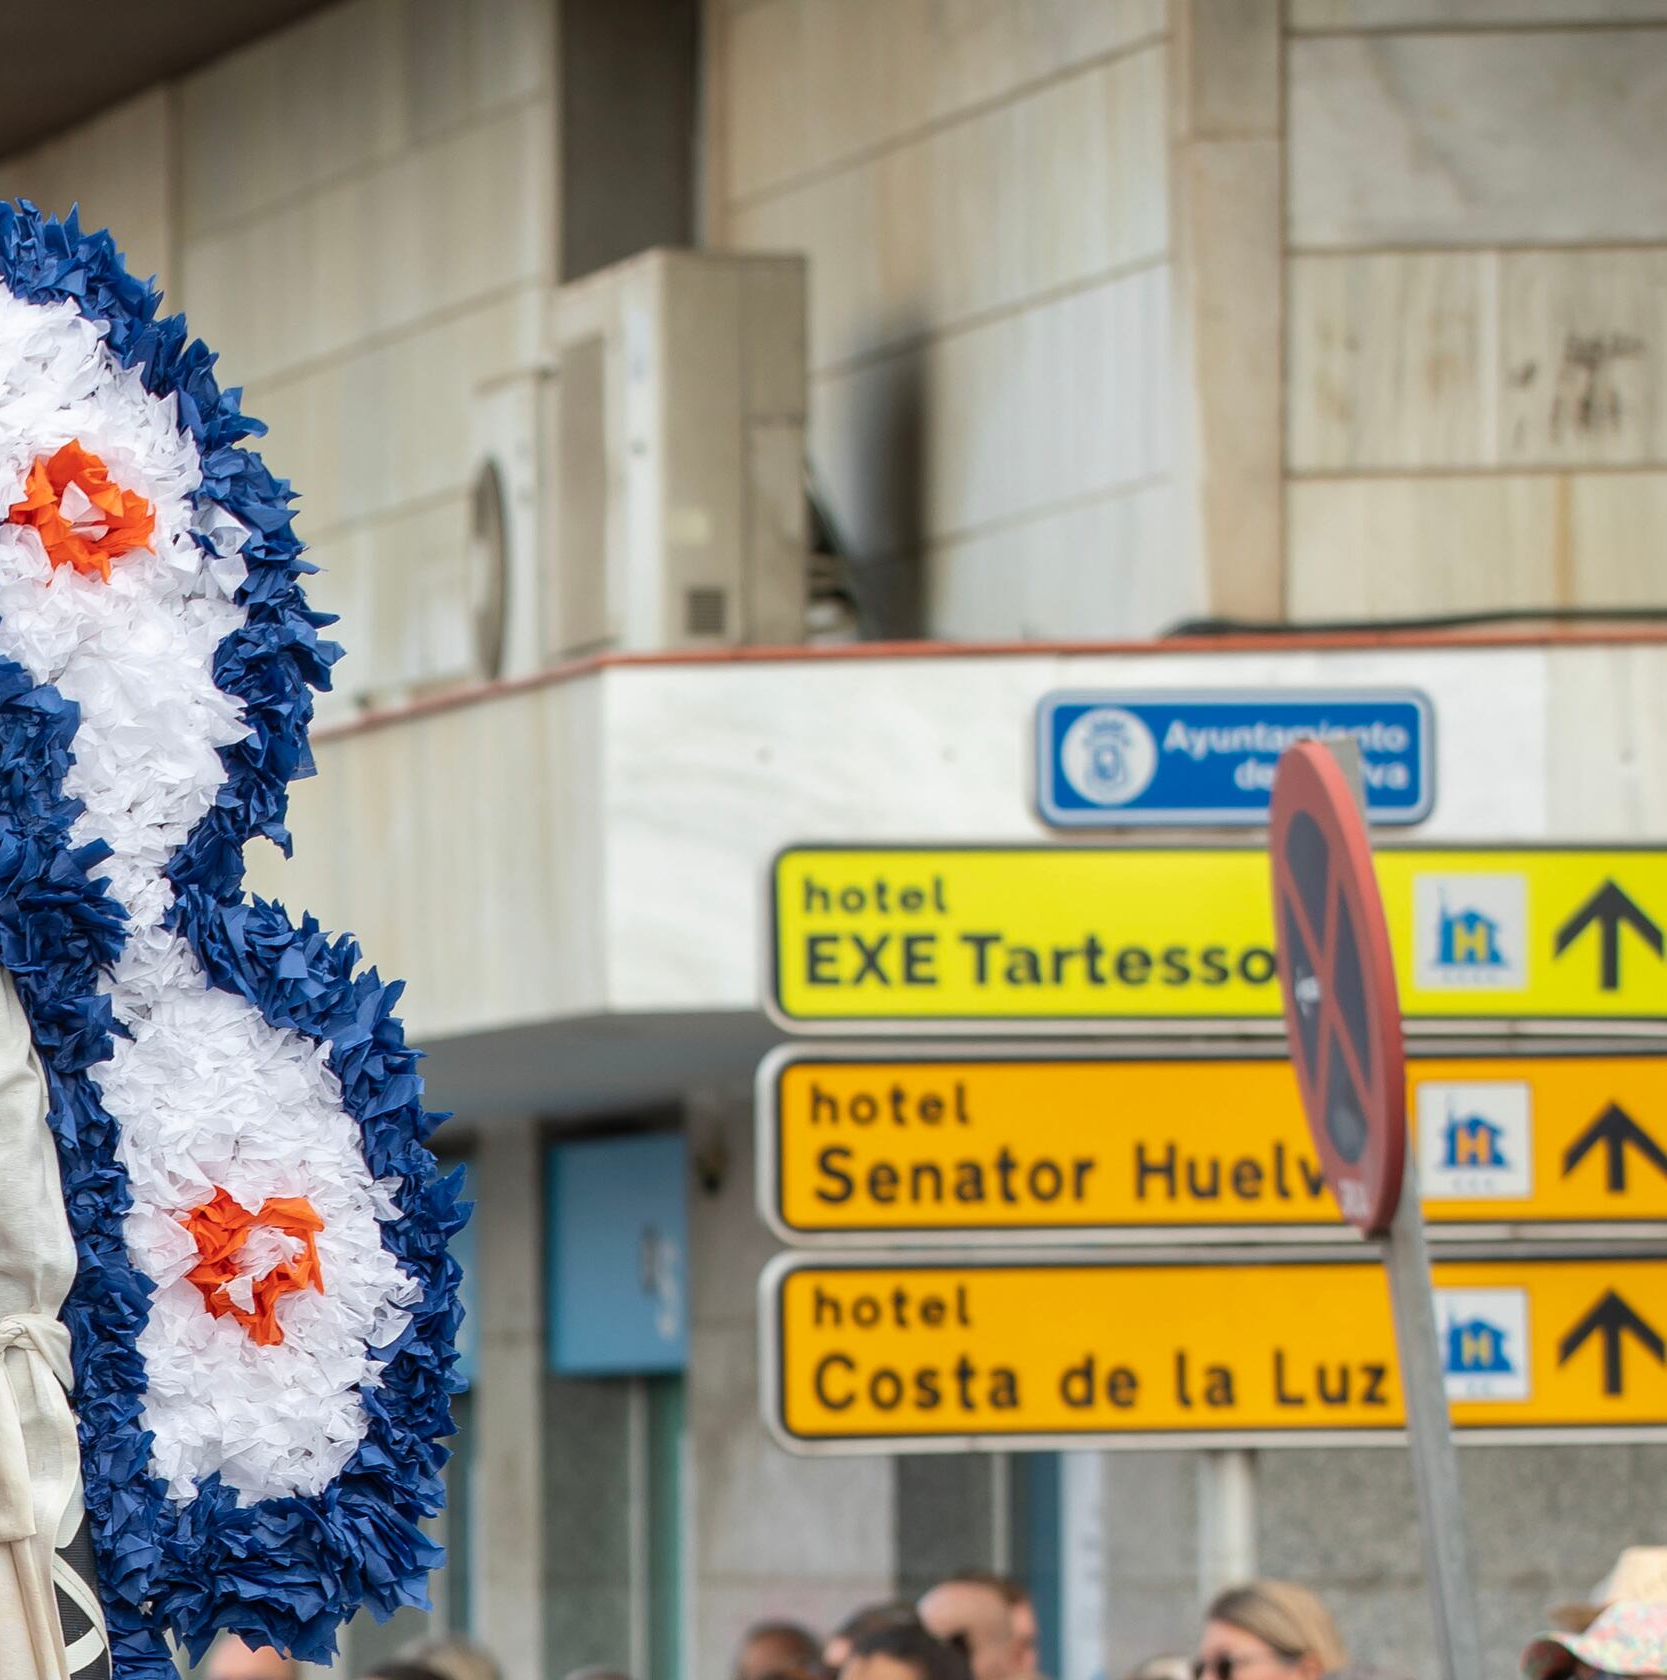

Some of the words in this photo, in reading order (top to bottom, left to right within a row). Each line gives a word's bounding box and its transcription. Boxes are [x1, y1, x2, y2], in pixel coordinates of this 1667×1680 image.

[805, 876, 948, 916] hotel
[805, 932, 938, 986] EXE
[960, 934, 1277, 986] Tartesso
[810, 1084, 969, 1126] hotel
[815, 1146, 1095, 1204] Senator
[1134, 1143, 1327, 1199] Huelv
[813, 1286, 971, 1329] hotel
[813, 1353, 1020, 1411] Costa
[1060, 1353, 1138, 1407] de
[1177, 1352, 1235, 1407] la
[1274, 1352, 1389, 1406] Luz
